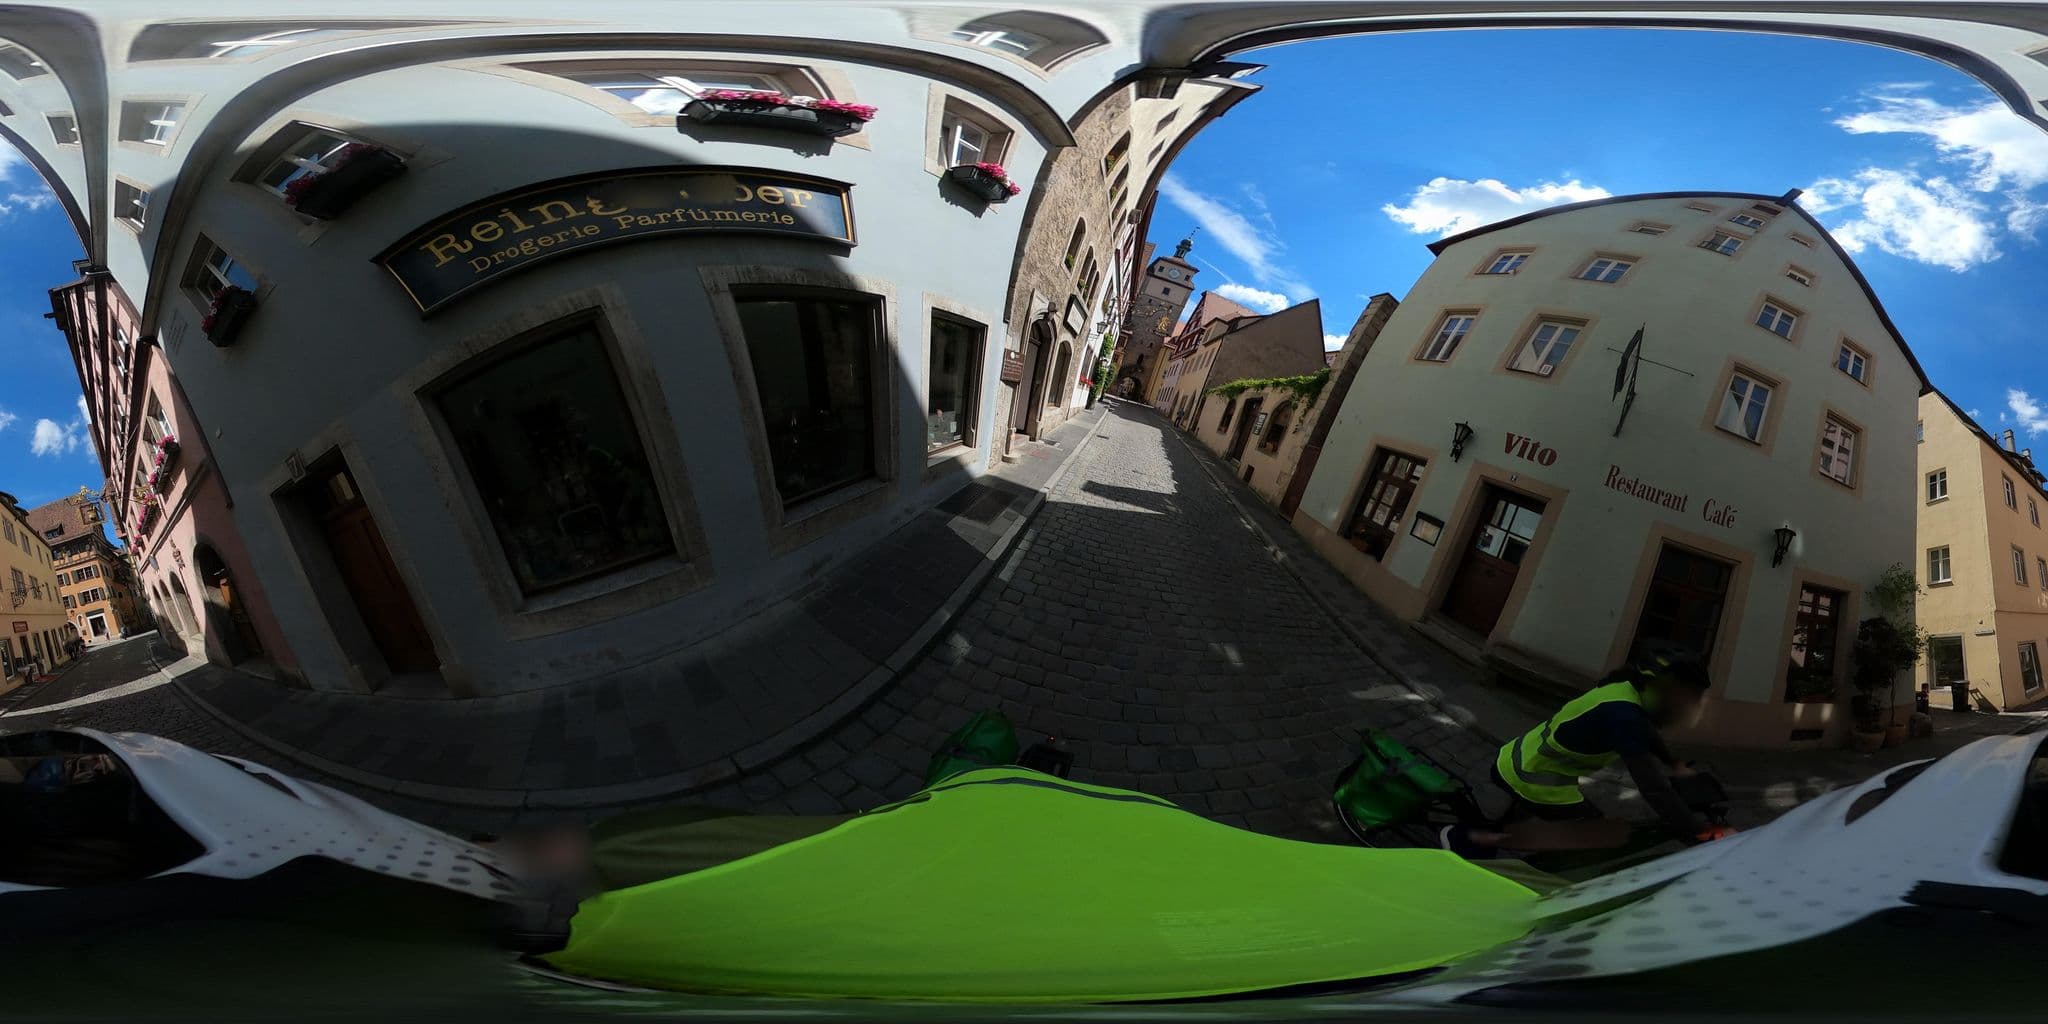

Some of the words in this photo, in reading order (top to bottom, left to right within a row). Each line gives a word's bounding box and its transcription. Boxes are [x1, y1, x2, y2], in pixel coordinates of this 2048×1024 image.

[468, 225, 600, 272] Drogerie
[615, 207, 795, 230] Parfümerie
[1504, 432, 1557, 466] Vito
[1604, 464, 1688, 513] Restaurant
[1702, 498, 1738, 529] Café
